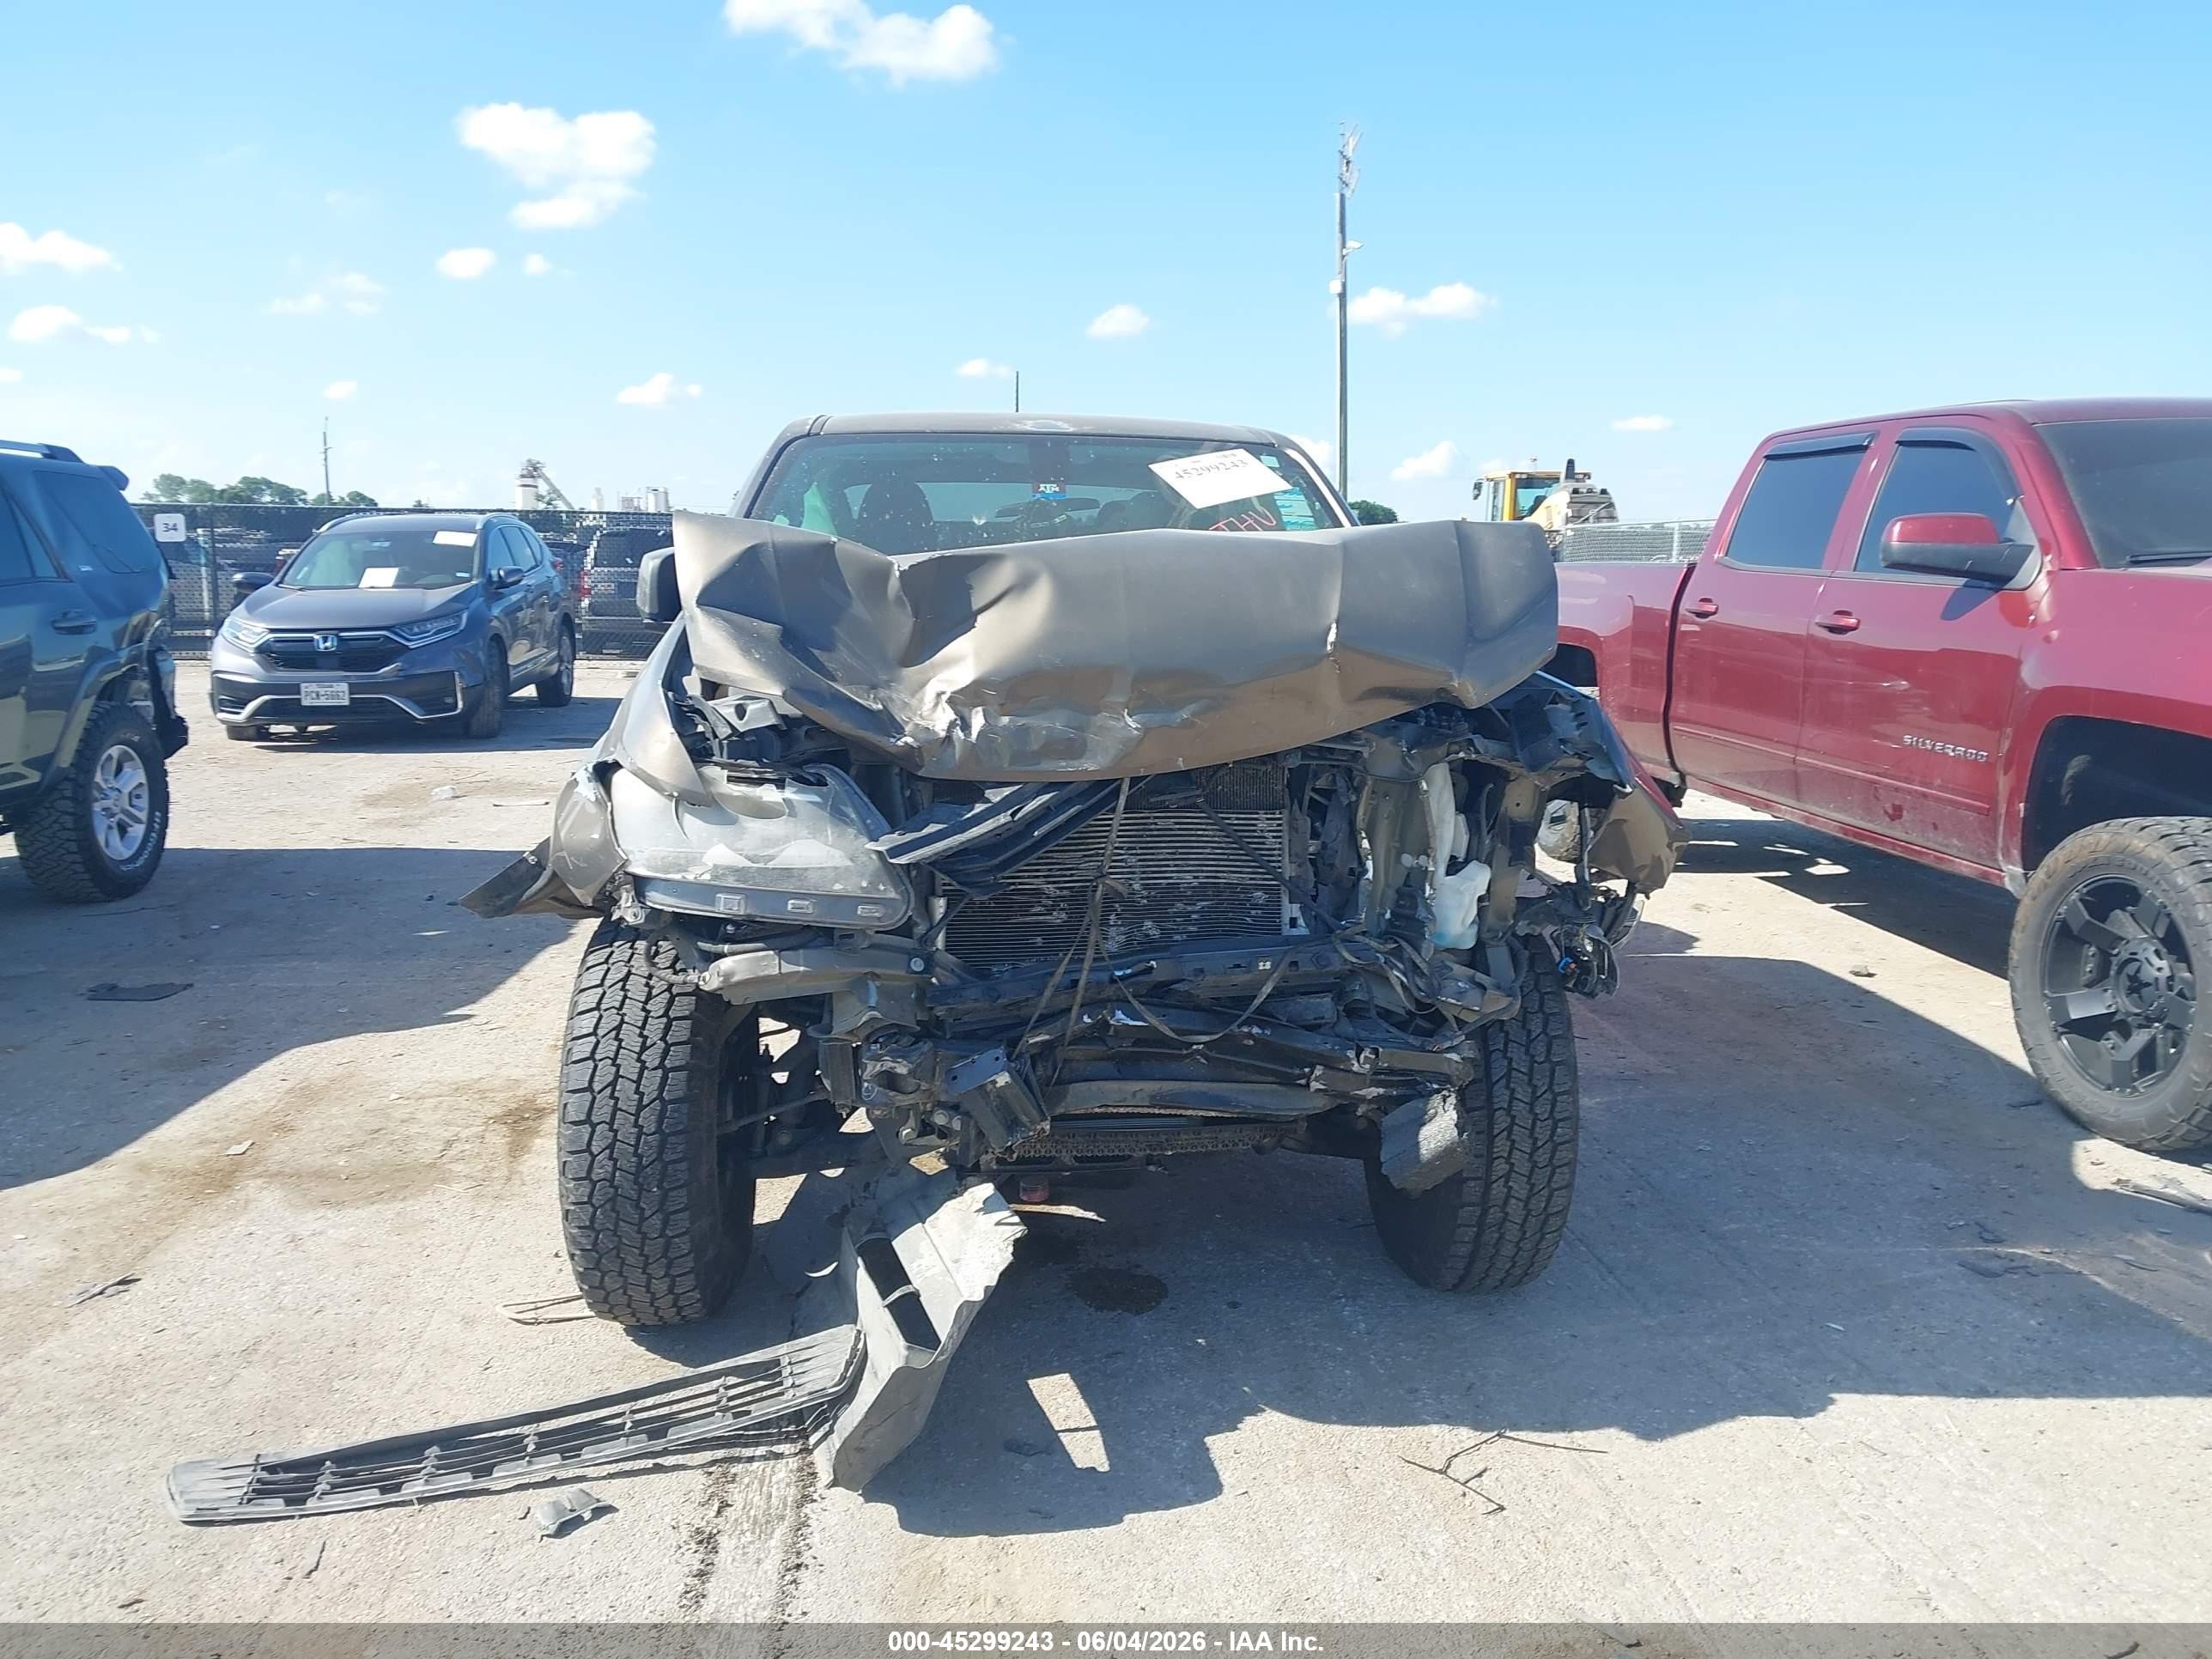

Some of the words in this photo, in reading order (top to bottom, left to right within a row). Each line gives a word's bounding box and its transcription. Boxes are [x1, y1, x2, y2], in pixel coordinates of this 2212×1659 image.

[1175, 459, 1249, 480] 45299243
[162, 522, 179, 532] 34
[1902, 734, 1990, 763] SILVERADO
